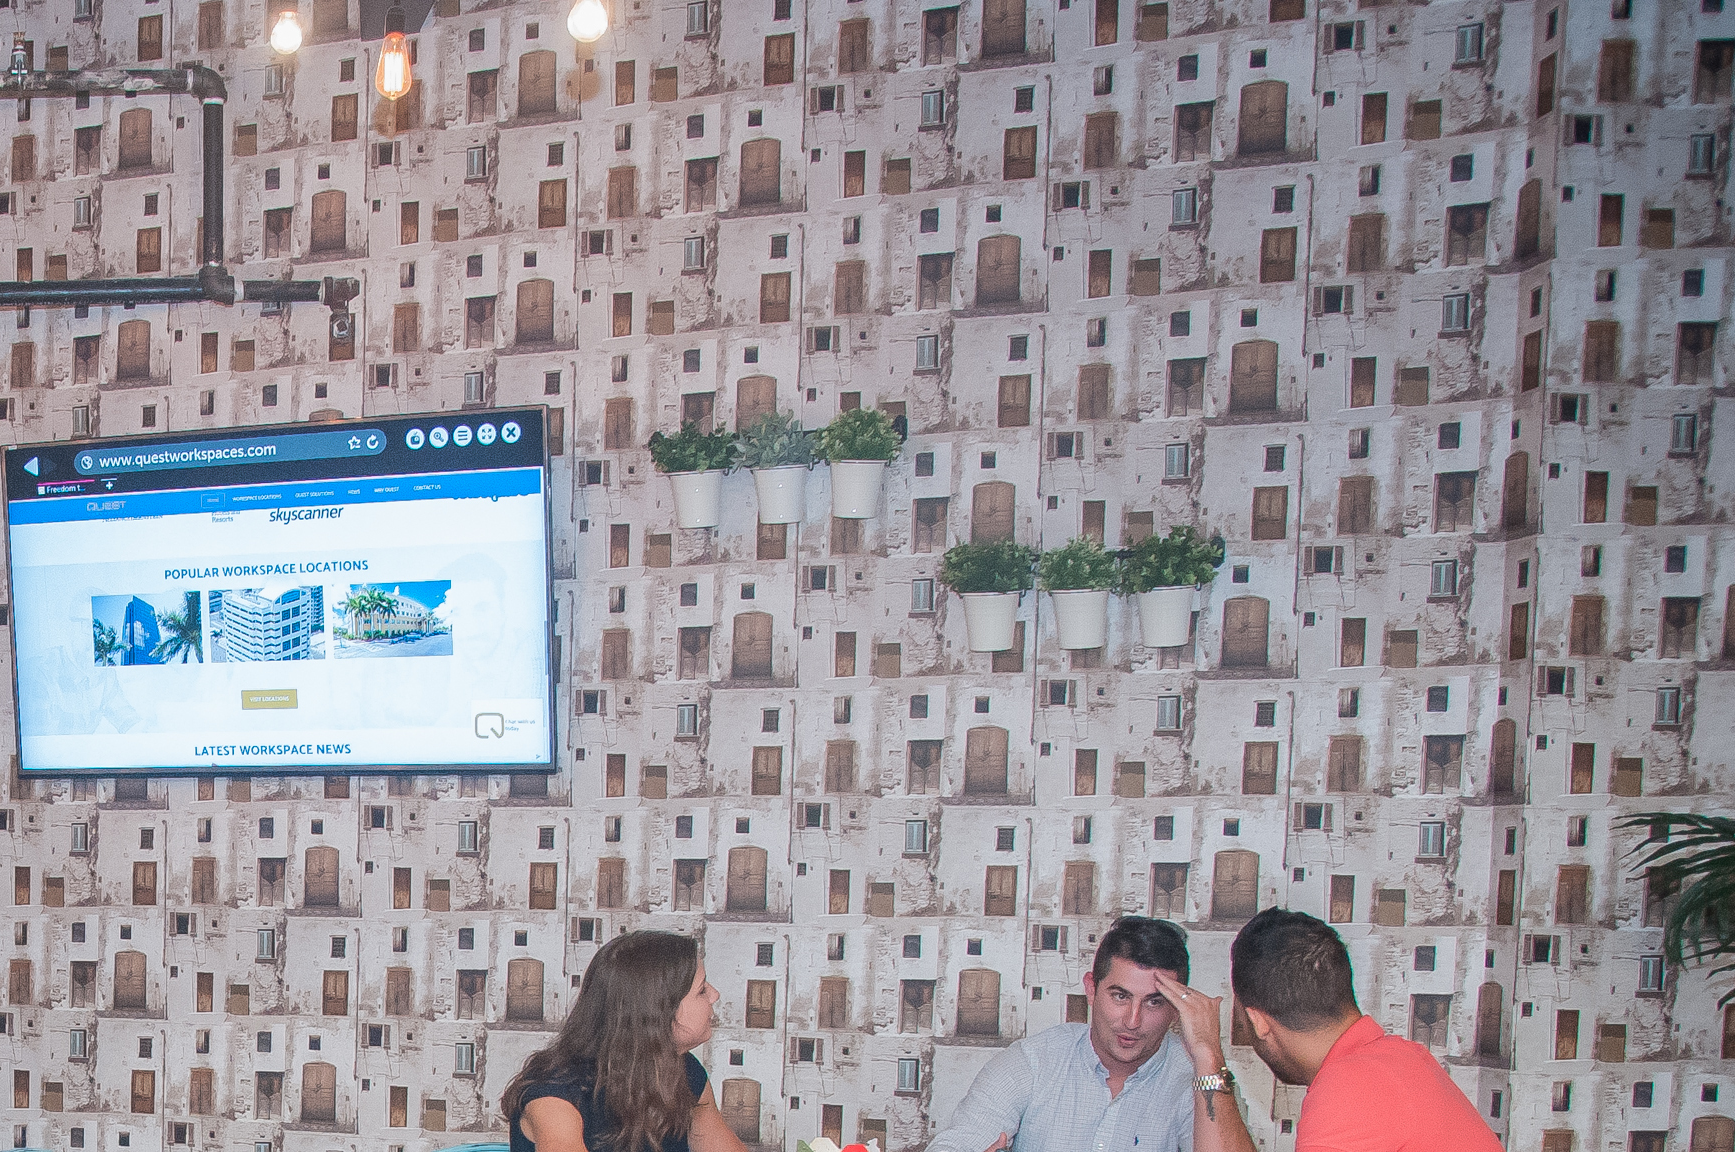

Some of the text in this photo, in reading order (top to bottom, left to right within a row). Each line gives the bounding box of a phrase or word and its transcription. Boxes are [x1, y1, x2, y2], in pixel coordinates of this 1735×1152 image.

[99, 445, 277, 468] www.questworkspaces.com
[46, 486, 76, 494] Freedom
[269, 507, 343, 525] skyscanner
[164, 560, 368, 579] POPULAR WORKSPACE LOCATIONS
[195, 743, 351, 756] LATEST WORKSPACE NEWS
